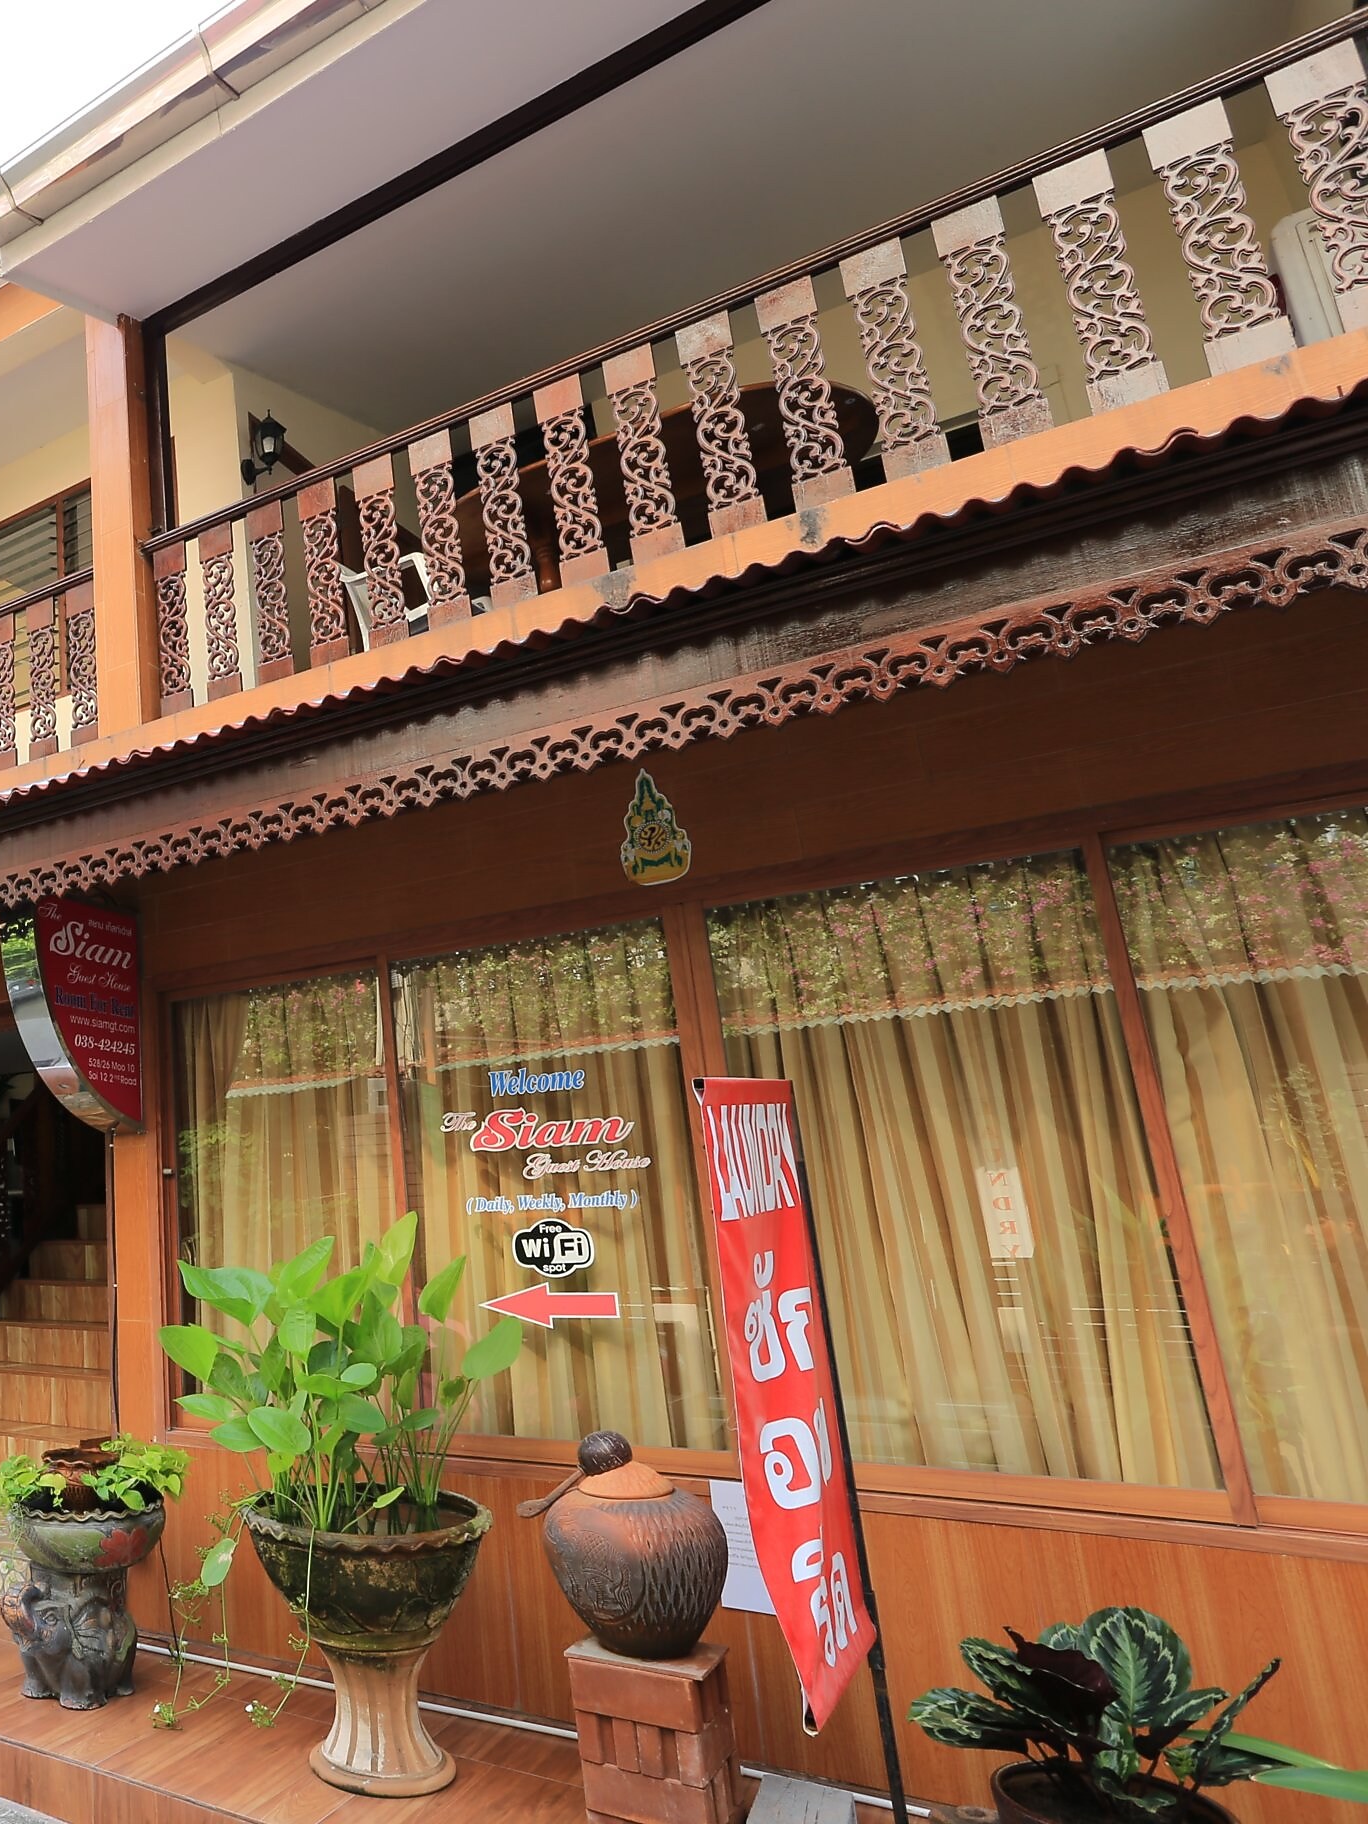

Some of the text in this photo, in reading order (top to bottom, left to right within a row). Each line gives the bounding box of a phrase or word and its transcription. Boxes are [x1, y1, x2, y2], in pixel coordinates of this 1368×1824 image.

[38, 903, 62, 920] The
[49, 921, 132, 969] Siam
[66, 962, 132, 992] Guest House
[54, 985, 88, 1010] Room
[74, 1033, 135, 1056] 038-424245
[489, 1068, 585, 1097] Welcome
[440, 1107, 634, 1152] The Siam
[523, 1150, 651, 1180] Guest House
[706, 1103, 802, 1221] LAUNDRY
[517, 1193, 565, 1212] Weekly,
[539, 1224, 563, 1234] Free
[542, 1263, 567, 1274] spot
[744, 1250, 814, 1382] ซัก
